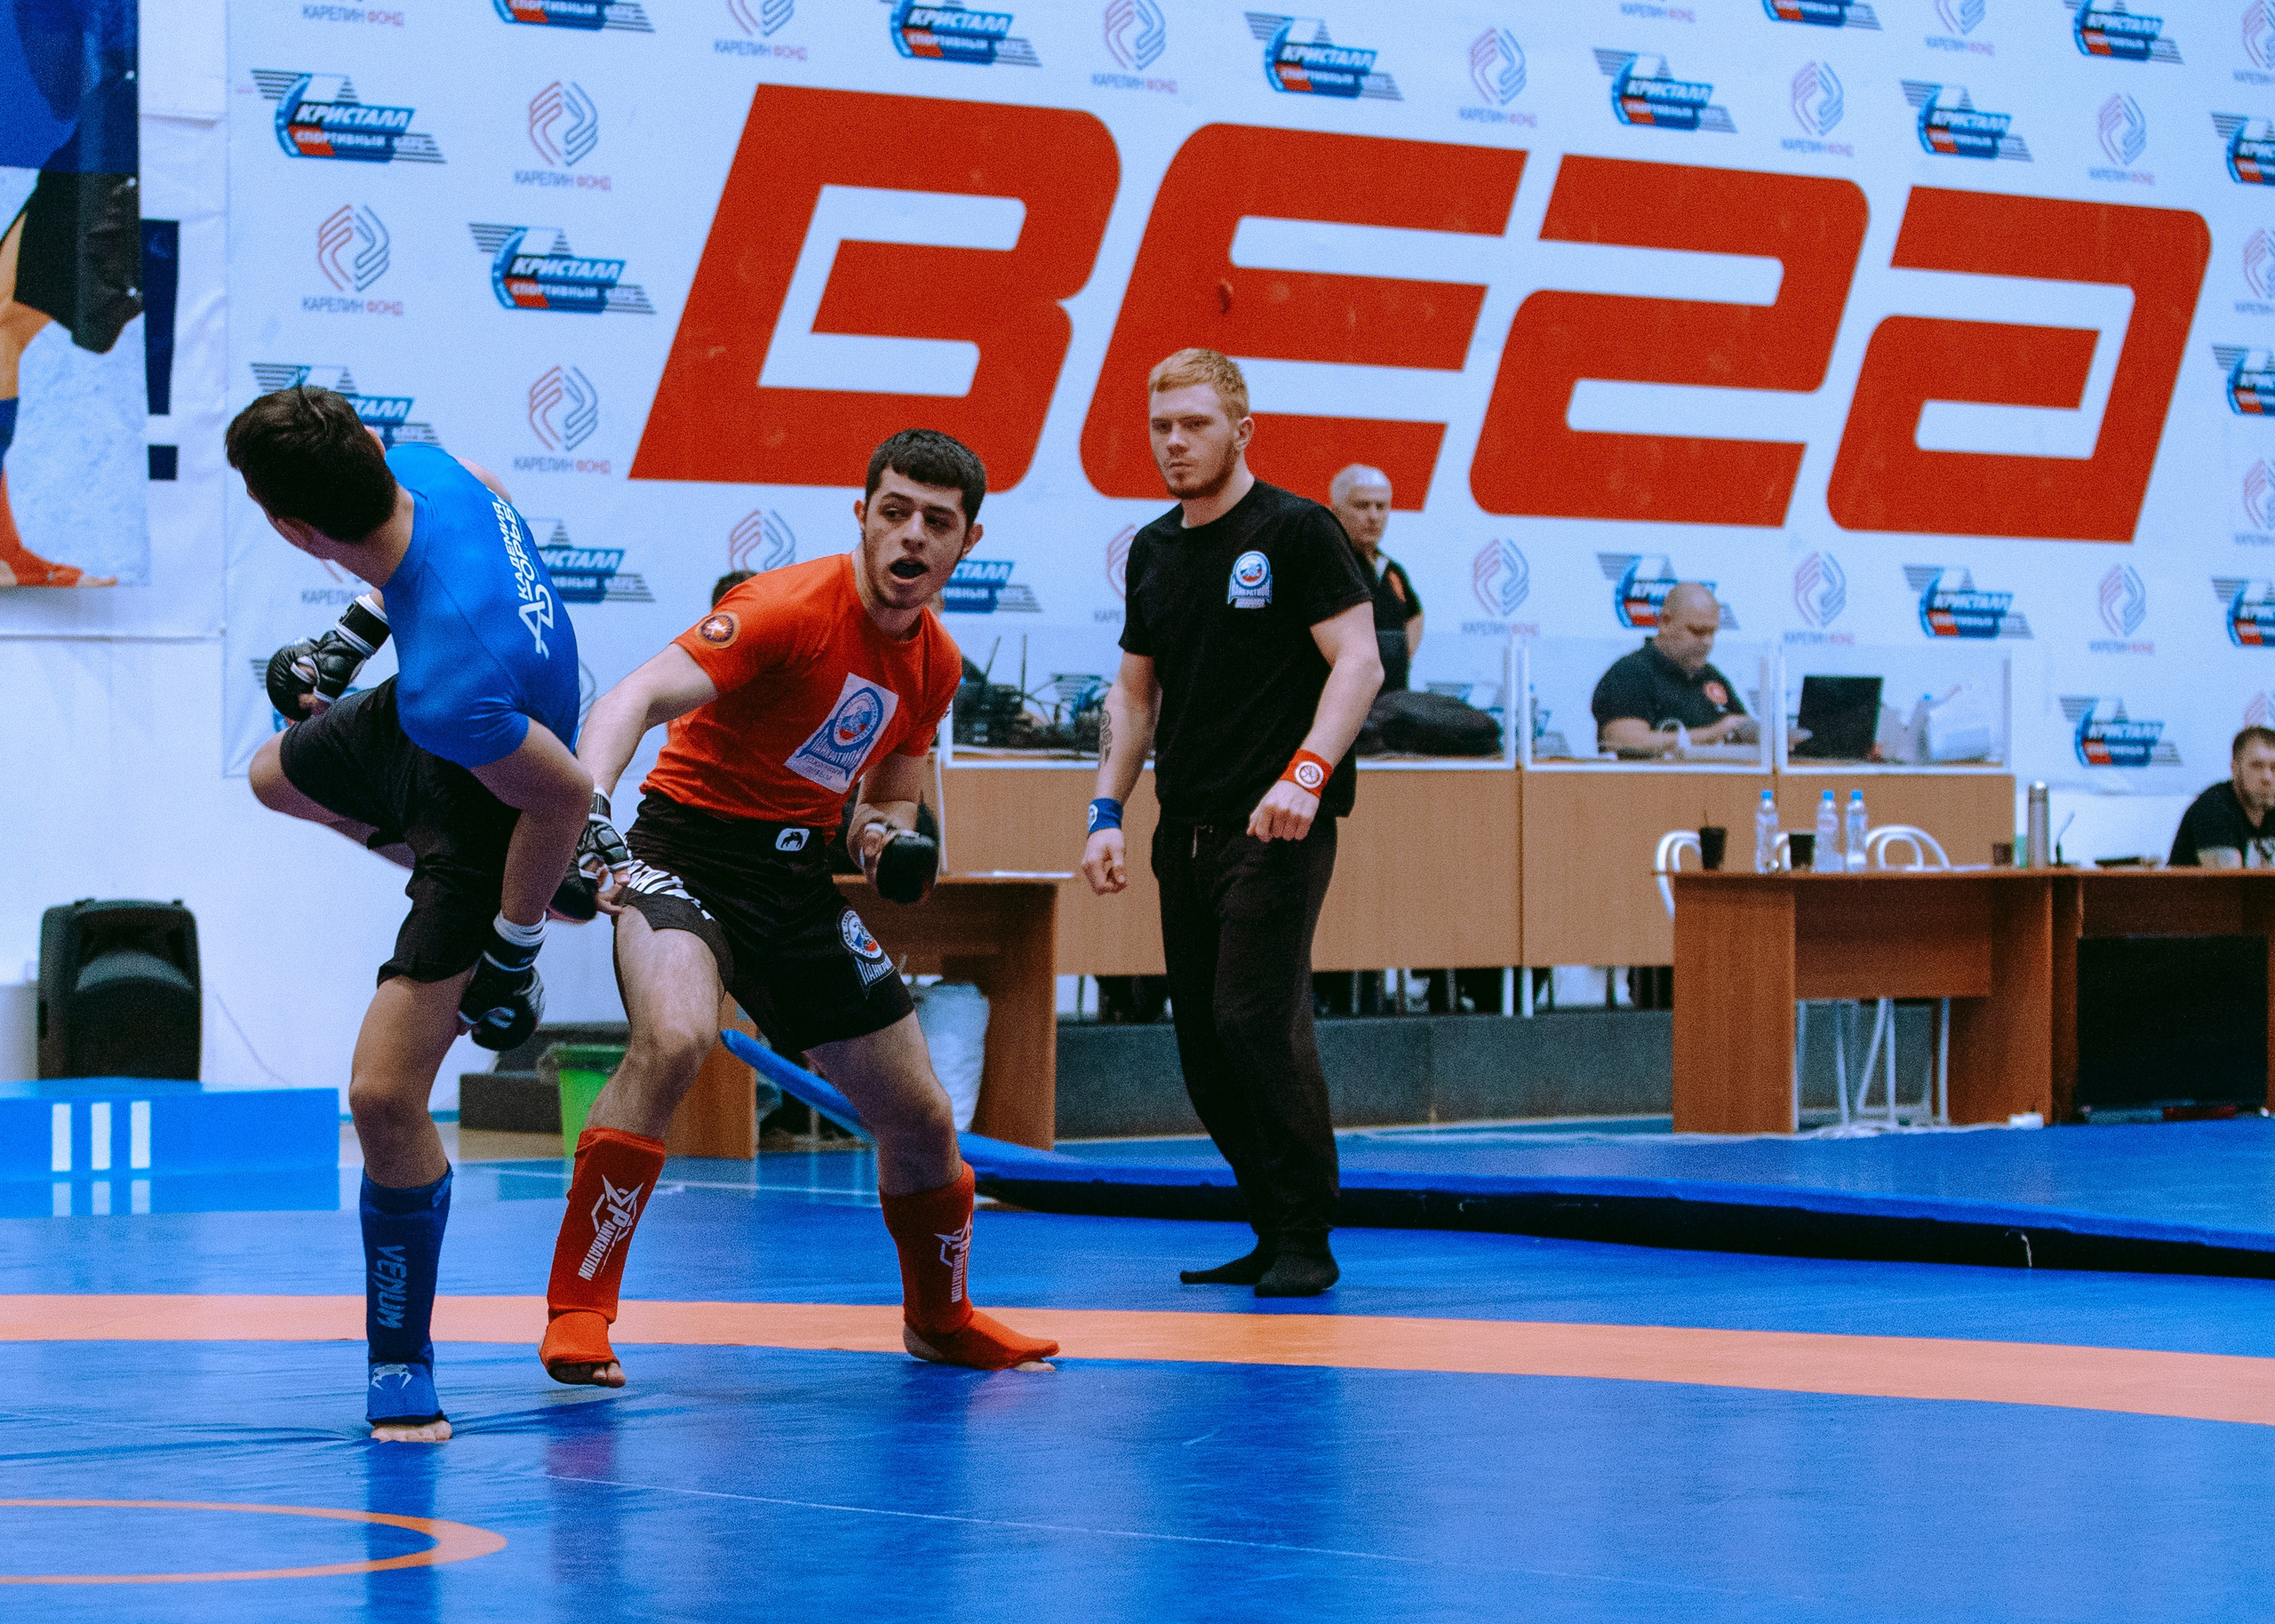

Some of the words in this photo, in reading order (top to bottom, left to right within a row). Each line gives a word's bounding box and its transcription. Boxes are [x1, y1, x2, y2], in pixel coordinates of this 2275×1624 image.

[302, 5, 364, 21] КАРЕЛИН
[365, 10, 404, 28] ФОНД
[907, 9, 1010, 32] КРИСТАЛЛ
[714, 39, 771, 56] КАРЕЛИН
[1281, 44, 1375, 67] КРИСТАЛЛ
[294, 104, 410, 127] КРИСТАЛЛ
[514, 170, 574, 187] КАРЕЛИН
[576, 174, 612, 191] ФОНД
[510, 255, 621, 278] КРИСТАЛЛ
[302, 297, 364, 313] КАРЕЛИН
[365, 300, 404, 317] ФОНД
[350, 398, 409, 418] ТАЛЛ
[513, 456, 574, 473] КАРЕЛИН
[576, 459, 612, 475] ФОНД
[545, 550, 620, 569] ИСТАЛЛ
[953, 561, 1010, 580] СТАЛЛ
[302, 588, 358, 605] КАРЕЛИ
[371, 1246, 408, 1329] VENUM
